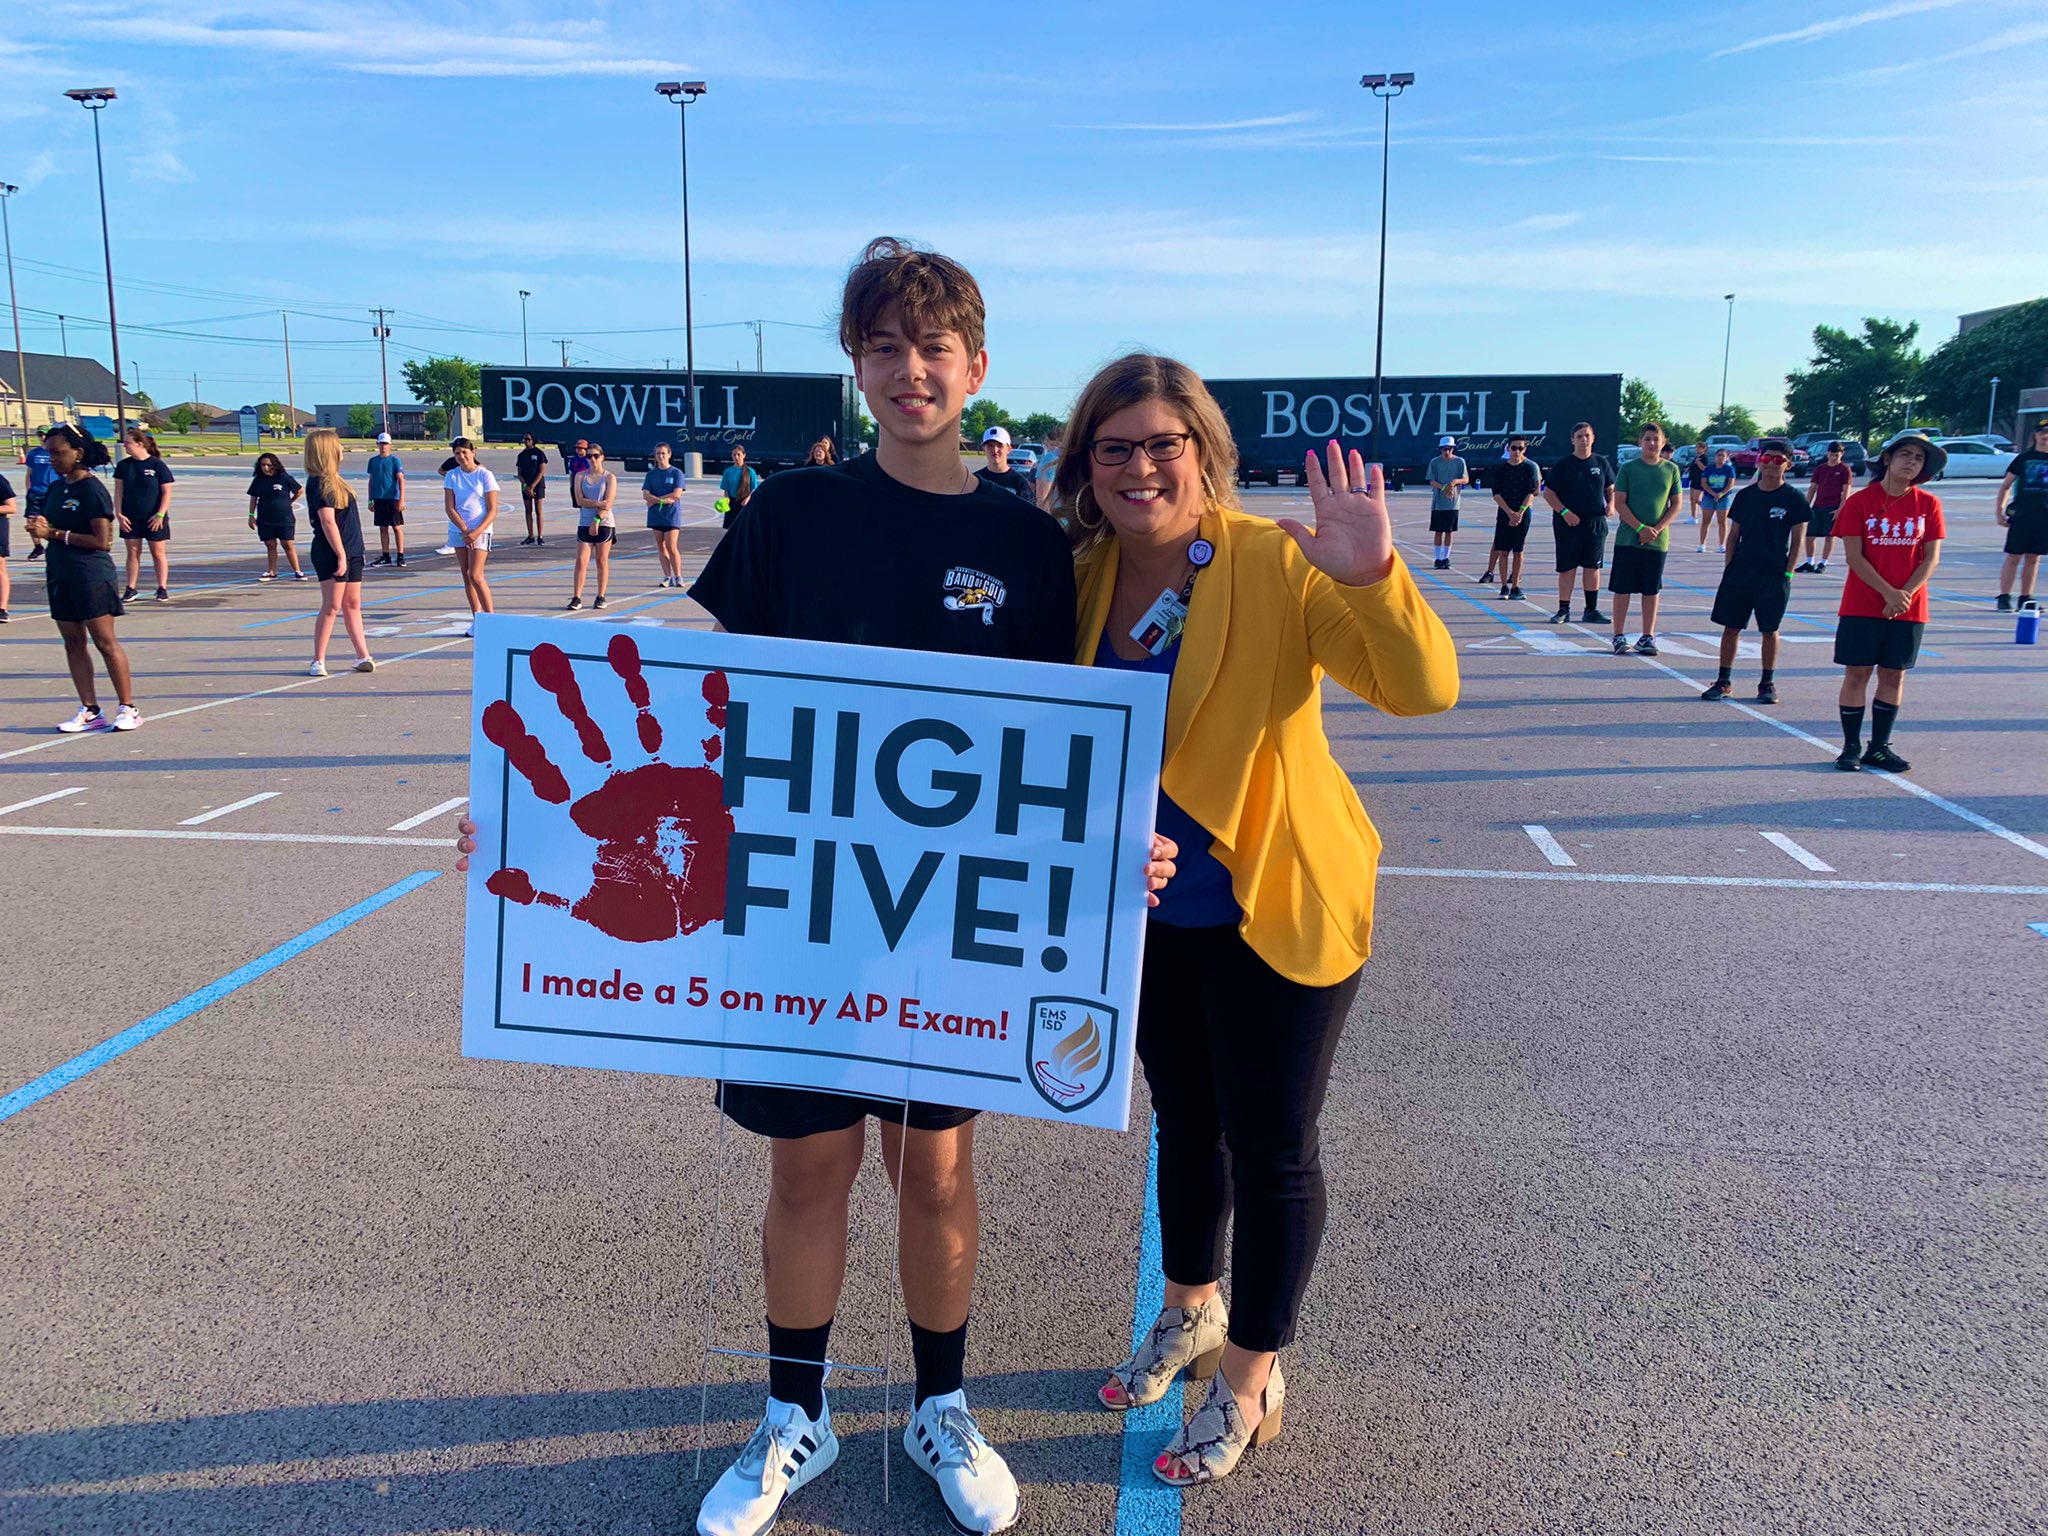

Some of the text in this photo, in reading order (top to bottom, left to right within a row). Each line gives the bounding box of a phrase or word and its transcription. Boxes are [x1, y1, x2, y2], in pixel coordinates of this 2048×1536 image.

[501, 377, 756, 429] BOSWELL
[1261, 390, 1547, 437] BOSWELL
[676, 428, 709, 443] Bnd
[1456, 436, 1493, 452] Band
[945, 571, 975, 587] BAND
[983, 581, 1005, 605] GOLD
[723, 700, 1094, 843] HIGH
[723, 832, 1074, 973] FIVE!
[522, 963, 1009, 1041] I made a 5 on my AP Exam!
[1040, 1008, 1067, 1021] EMS
[1042, 1019, 1063, 1031] ISD
